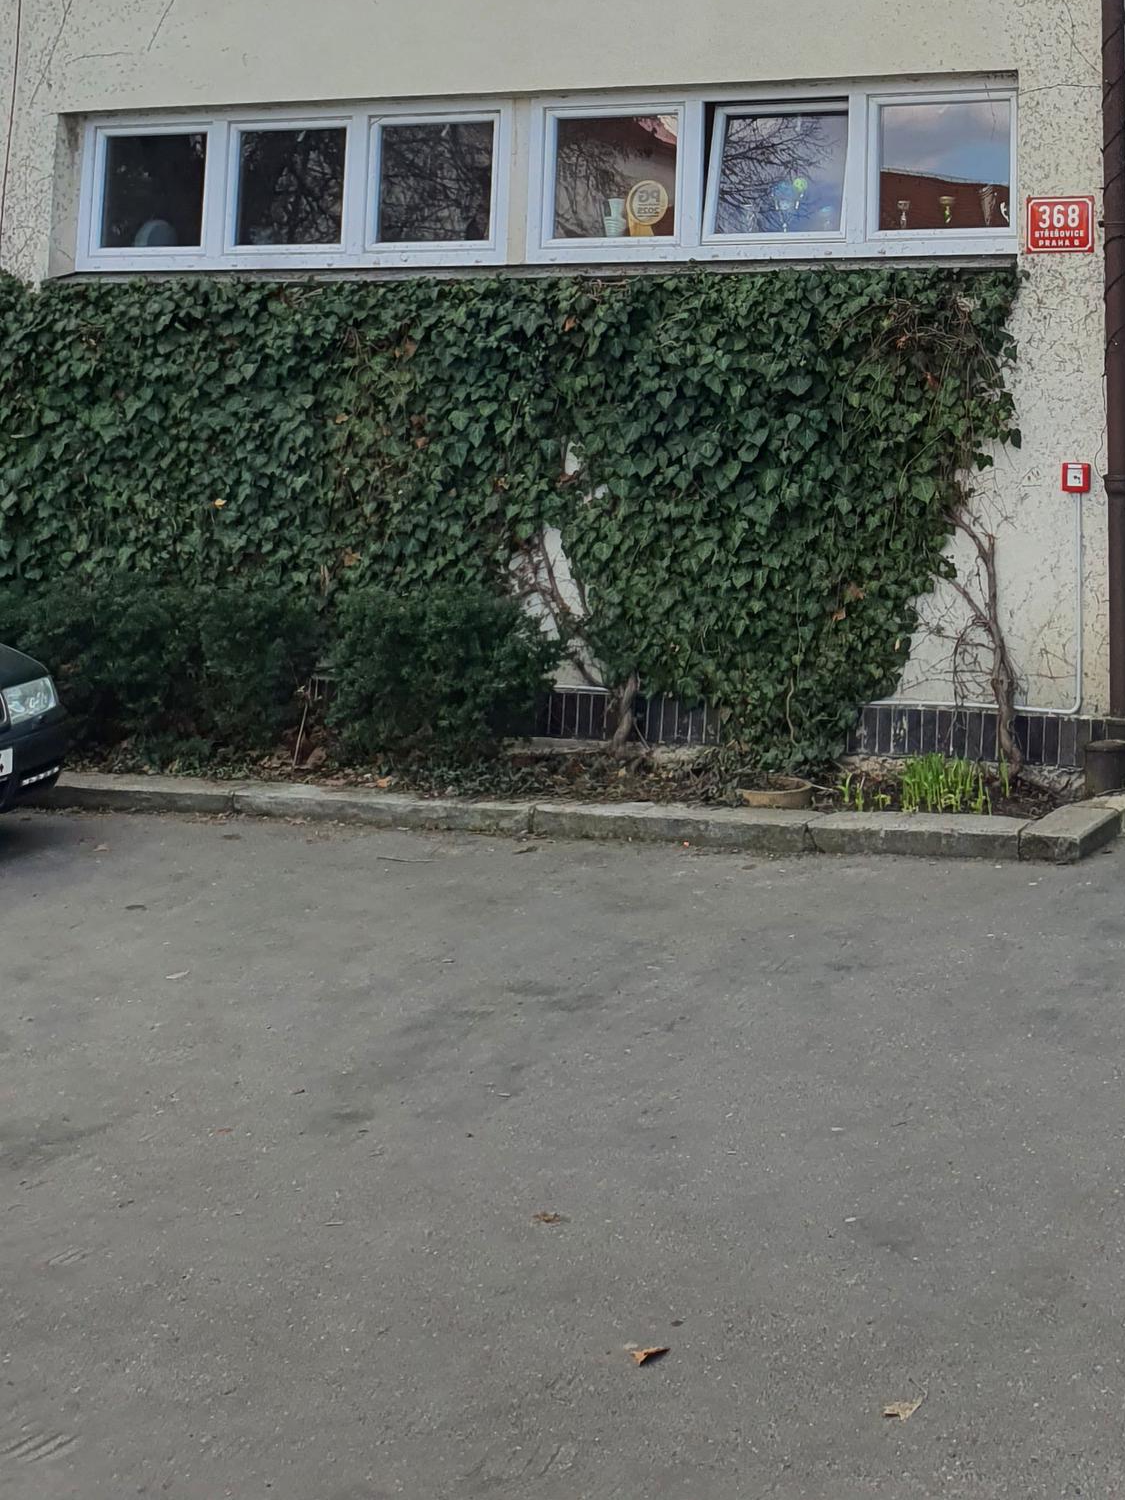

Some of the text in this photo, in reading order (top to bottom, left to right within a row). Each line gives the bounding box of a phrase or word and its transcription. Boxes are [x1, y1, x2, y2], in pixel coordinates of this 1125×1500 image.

[1038, 204, 1080, 229] 368
[1034, 229, 1085, 238] STŘEŠOVICE
[1038, 239, 1071, 247] PRAHA
